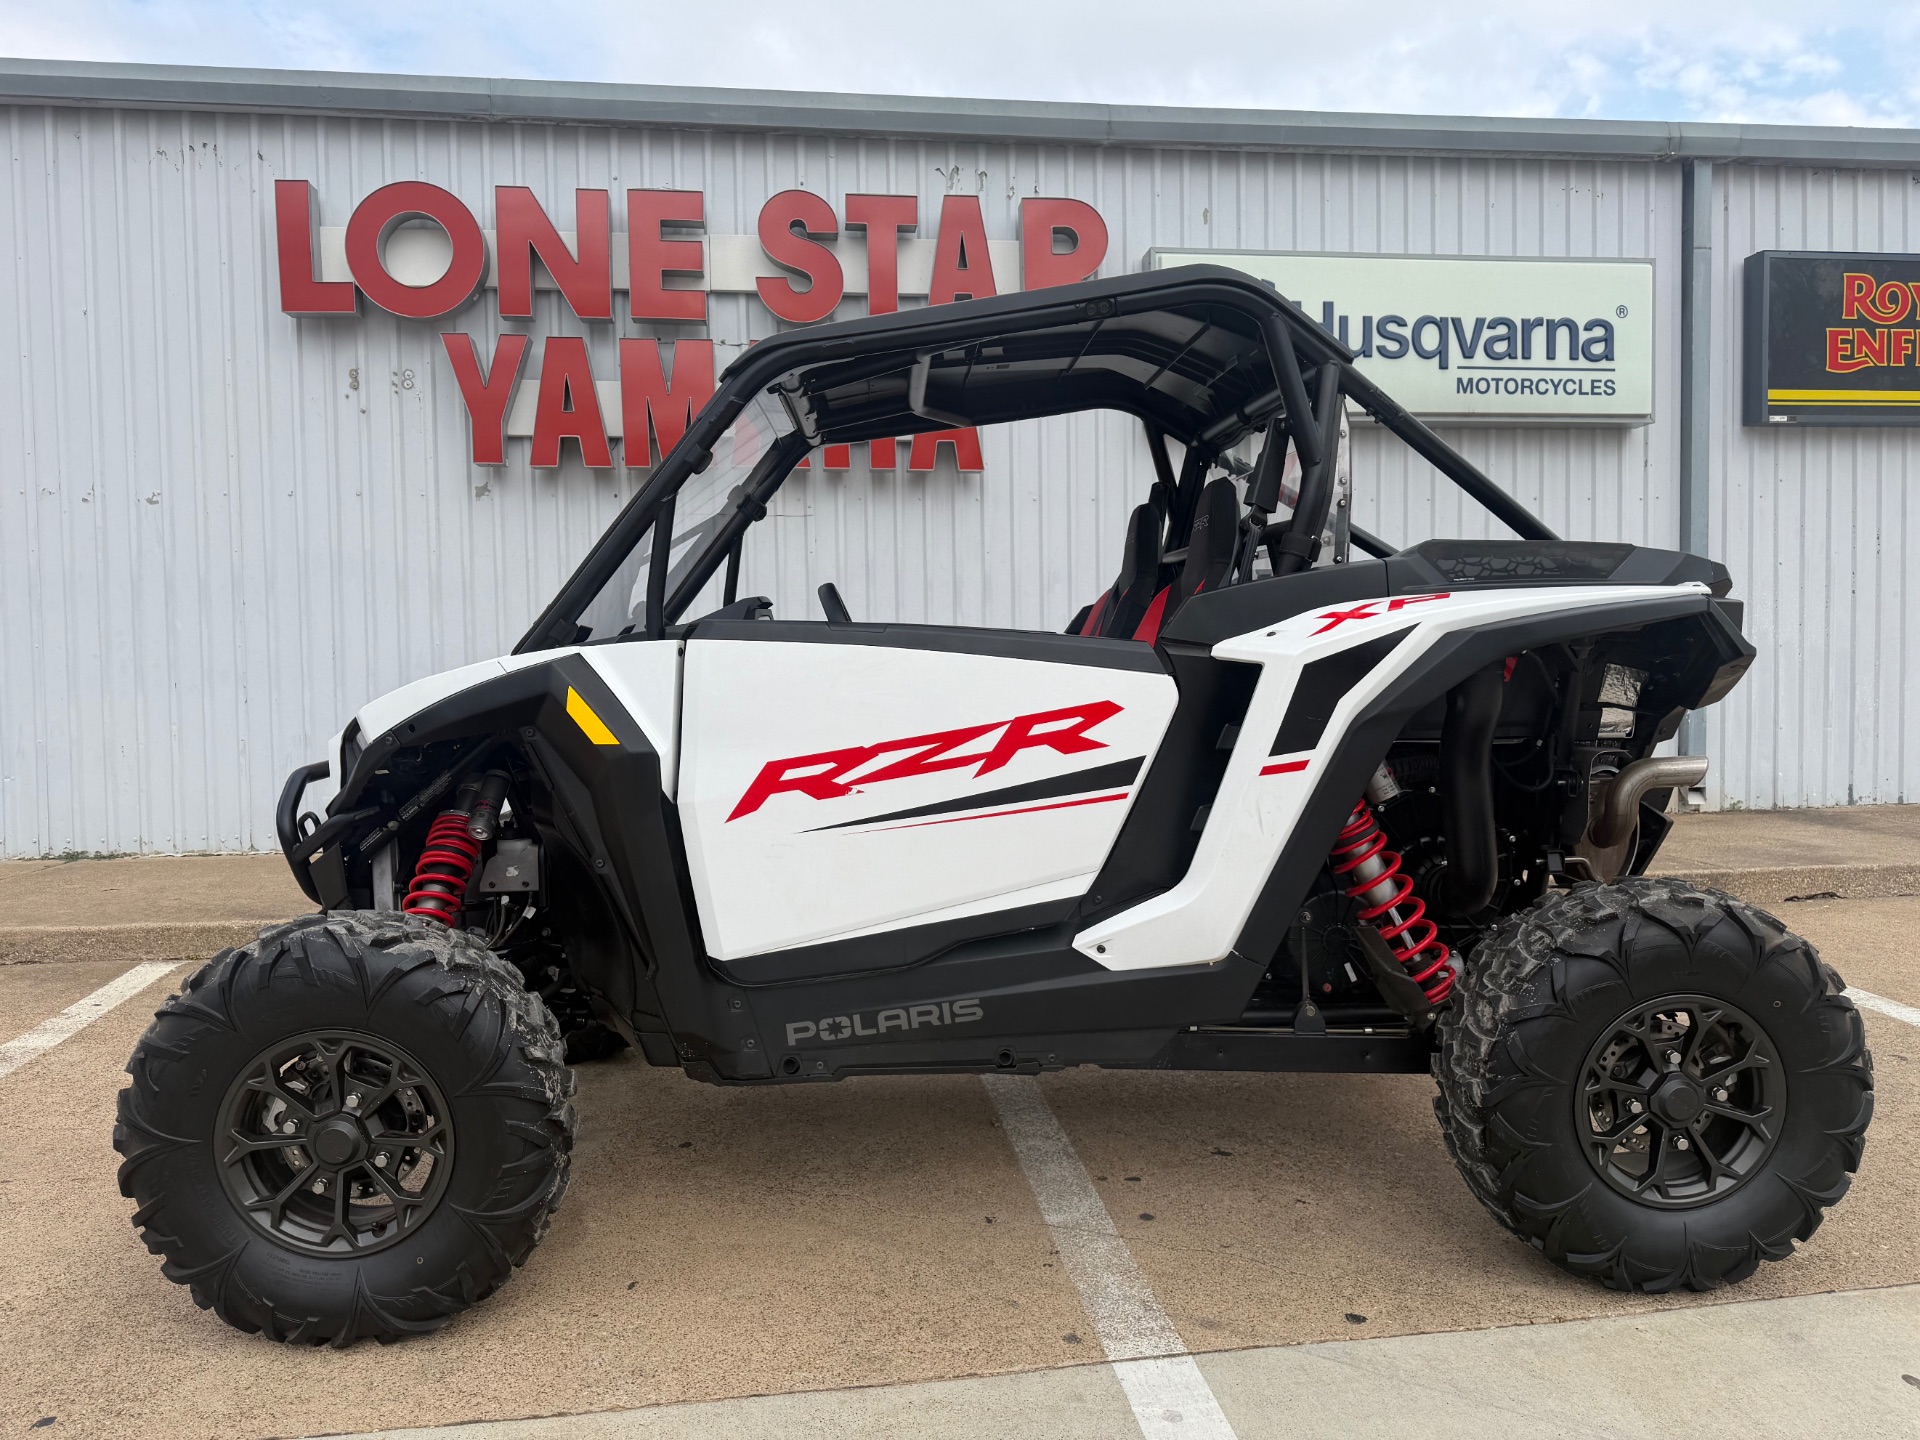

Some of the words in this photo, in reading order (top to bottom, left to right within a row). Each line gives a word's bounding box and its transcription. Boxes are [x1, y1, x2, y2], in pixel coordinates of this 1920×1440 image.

[275, 179, 707, 324] LONE
[1456, 377, 1616, 396] MOTORCYCLES
[1306, 593, 1451, 638] XP
[725, 700, 1125, 823] RZR
[786, 999, 983, 1046] POLARIS
